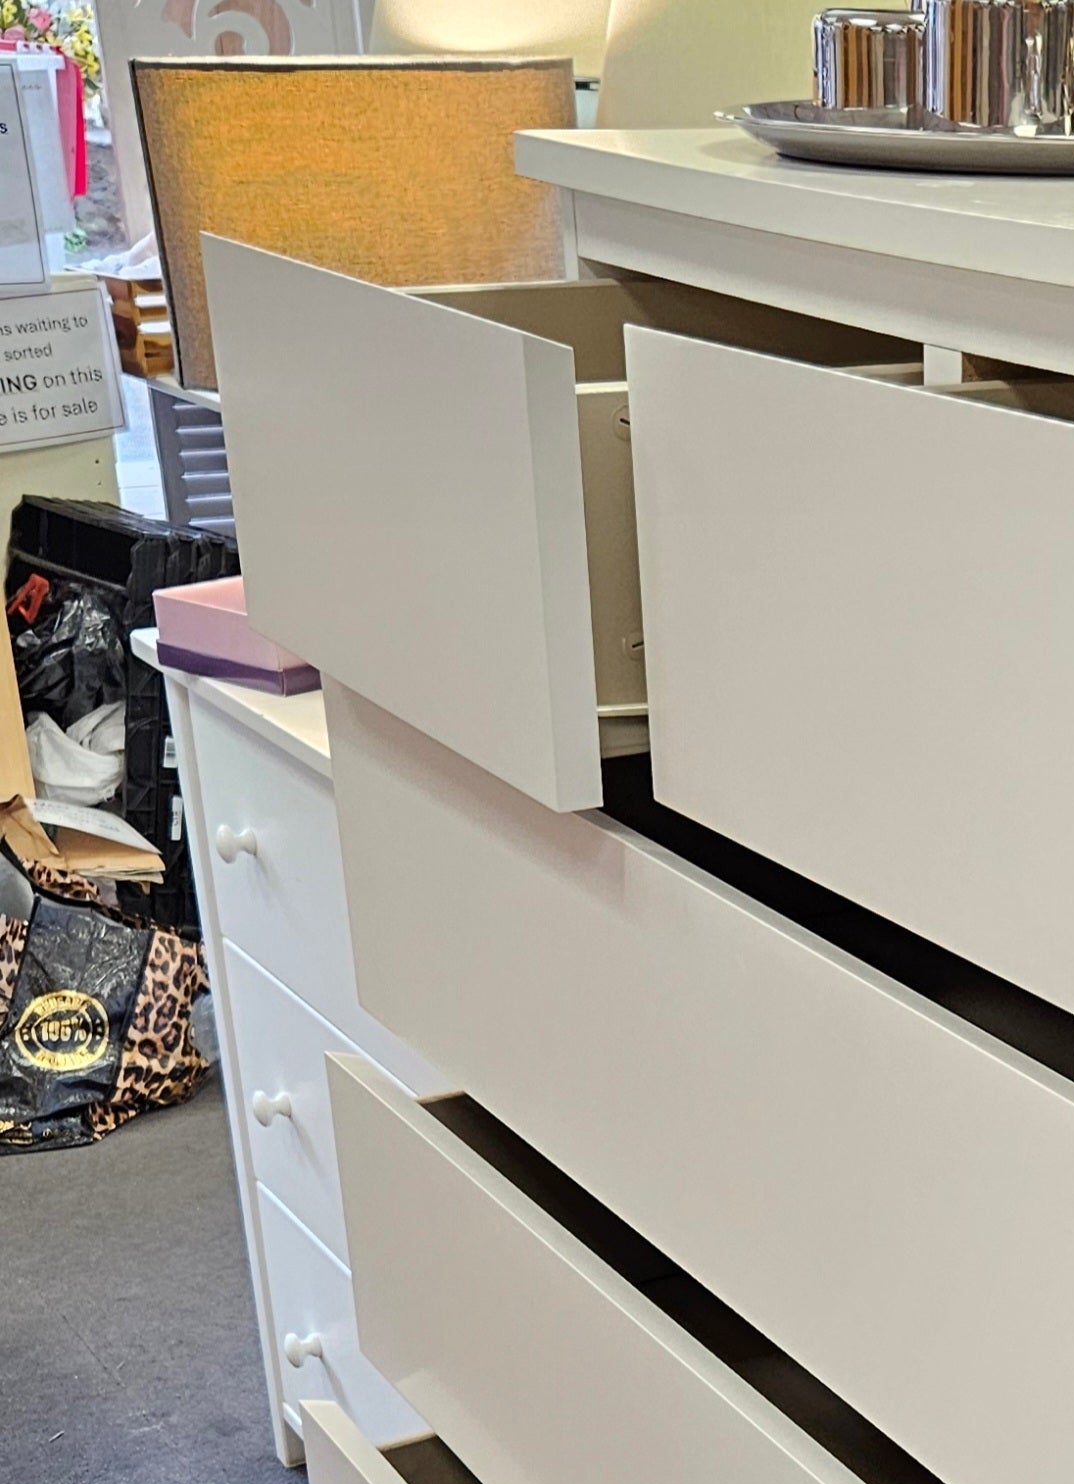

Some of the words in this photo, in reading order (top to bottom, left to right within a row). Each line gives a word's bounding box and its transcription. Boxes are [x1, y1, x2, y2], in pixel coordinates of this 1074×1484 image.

[16, 317, 71, 334] waiting
[73, 315, 88, 328] to
[4, 341, 53, 361] sorted
[43, 375, 66, 389] on
[70, 366, 103, 385] this
[12, 406, 28, 423] is
[33, 404, 56, 420] for
[62, 397, 98, 417] sale
